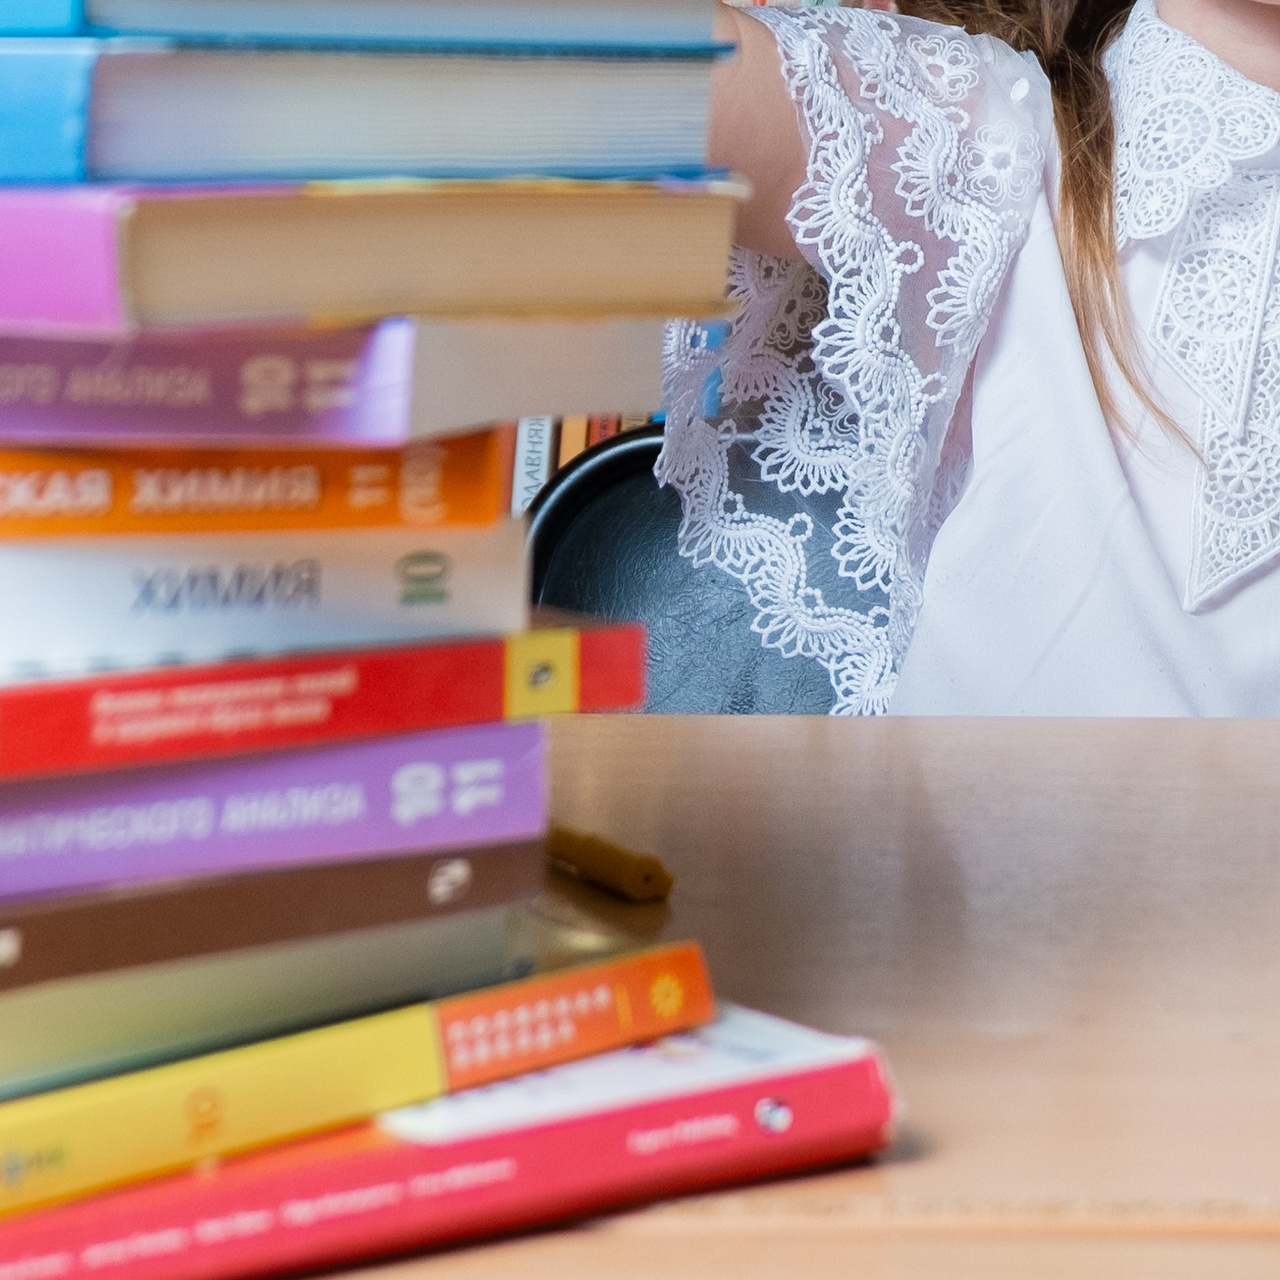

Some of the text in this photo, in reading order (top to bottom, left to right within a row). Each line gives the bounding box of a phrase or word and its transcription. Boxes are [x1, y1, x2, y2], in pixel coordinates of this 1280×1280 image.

[129, 465, 320, 513] ХИМИЯ
[131, 549, 451, 615] ХИМИЯ 10
[219, 782, 366, 834] АНАЛИЗА
